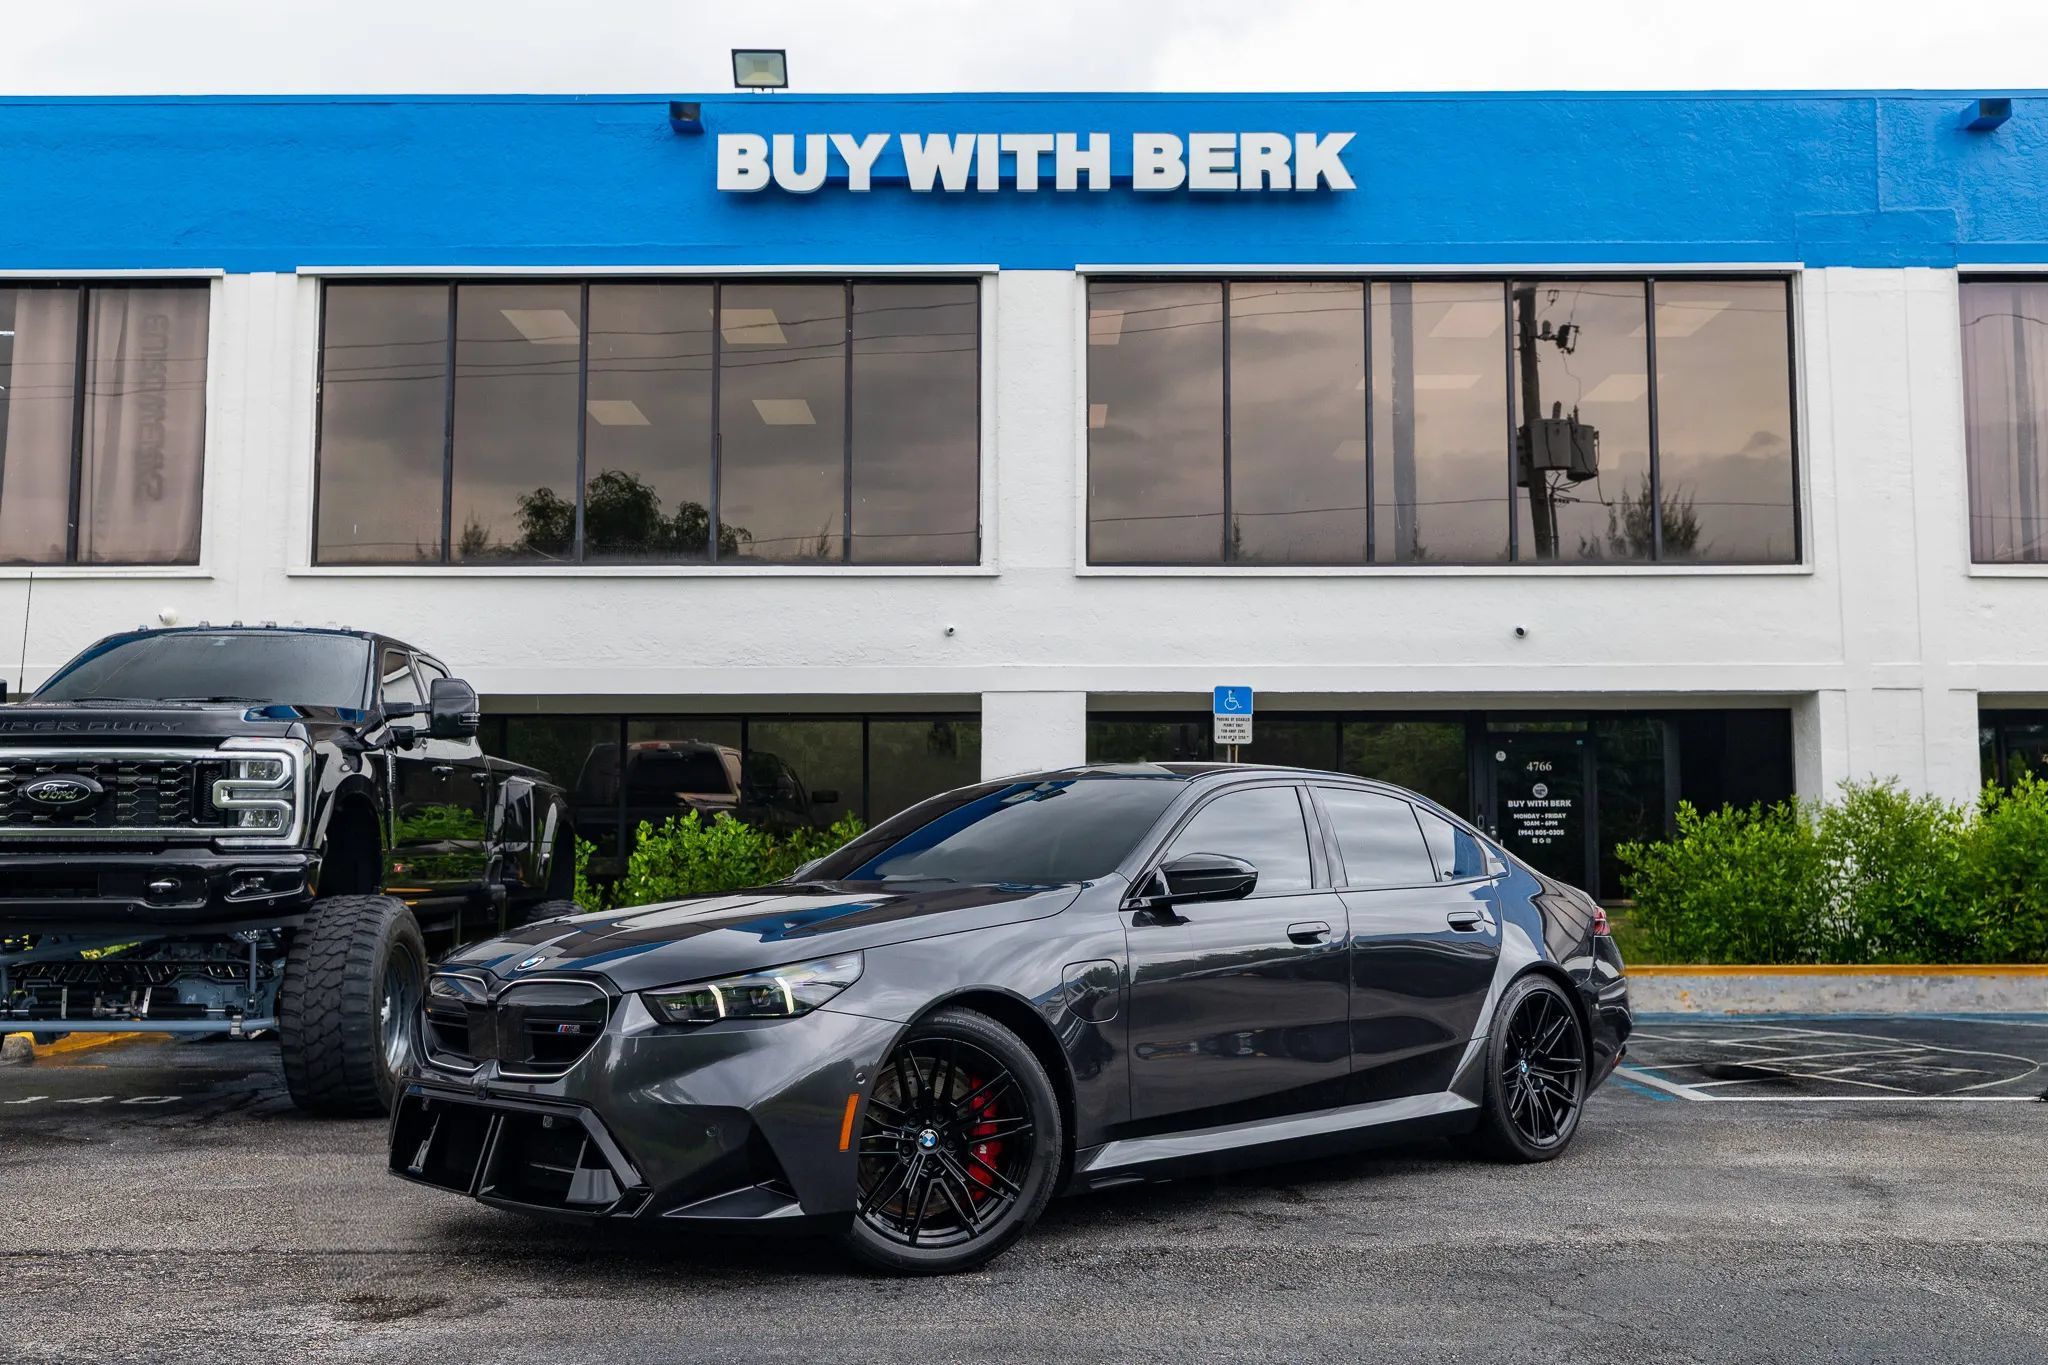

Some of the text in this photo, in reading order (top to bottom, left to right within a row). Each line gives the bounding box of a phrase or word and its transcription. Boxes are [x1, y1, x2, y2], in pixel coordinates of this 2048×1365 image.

[717, 132, 1357, 193] BUY WITH BERK
[1526, 761, 1552, 771] 4766
[39, 783, 78, 799] Ford
